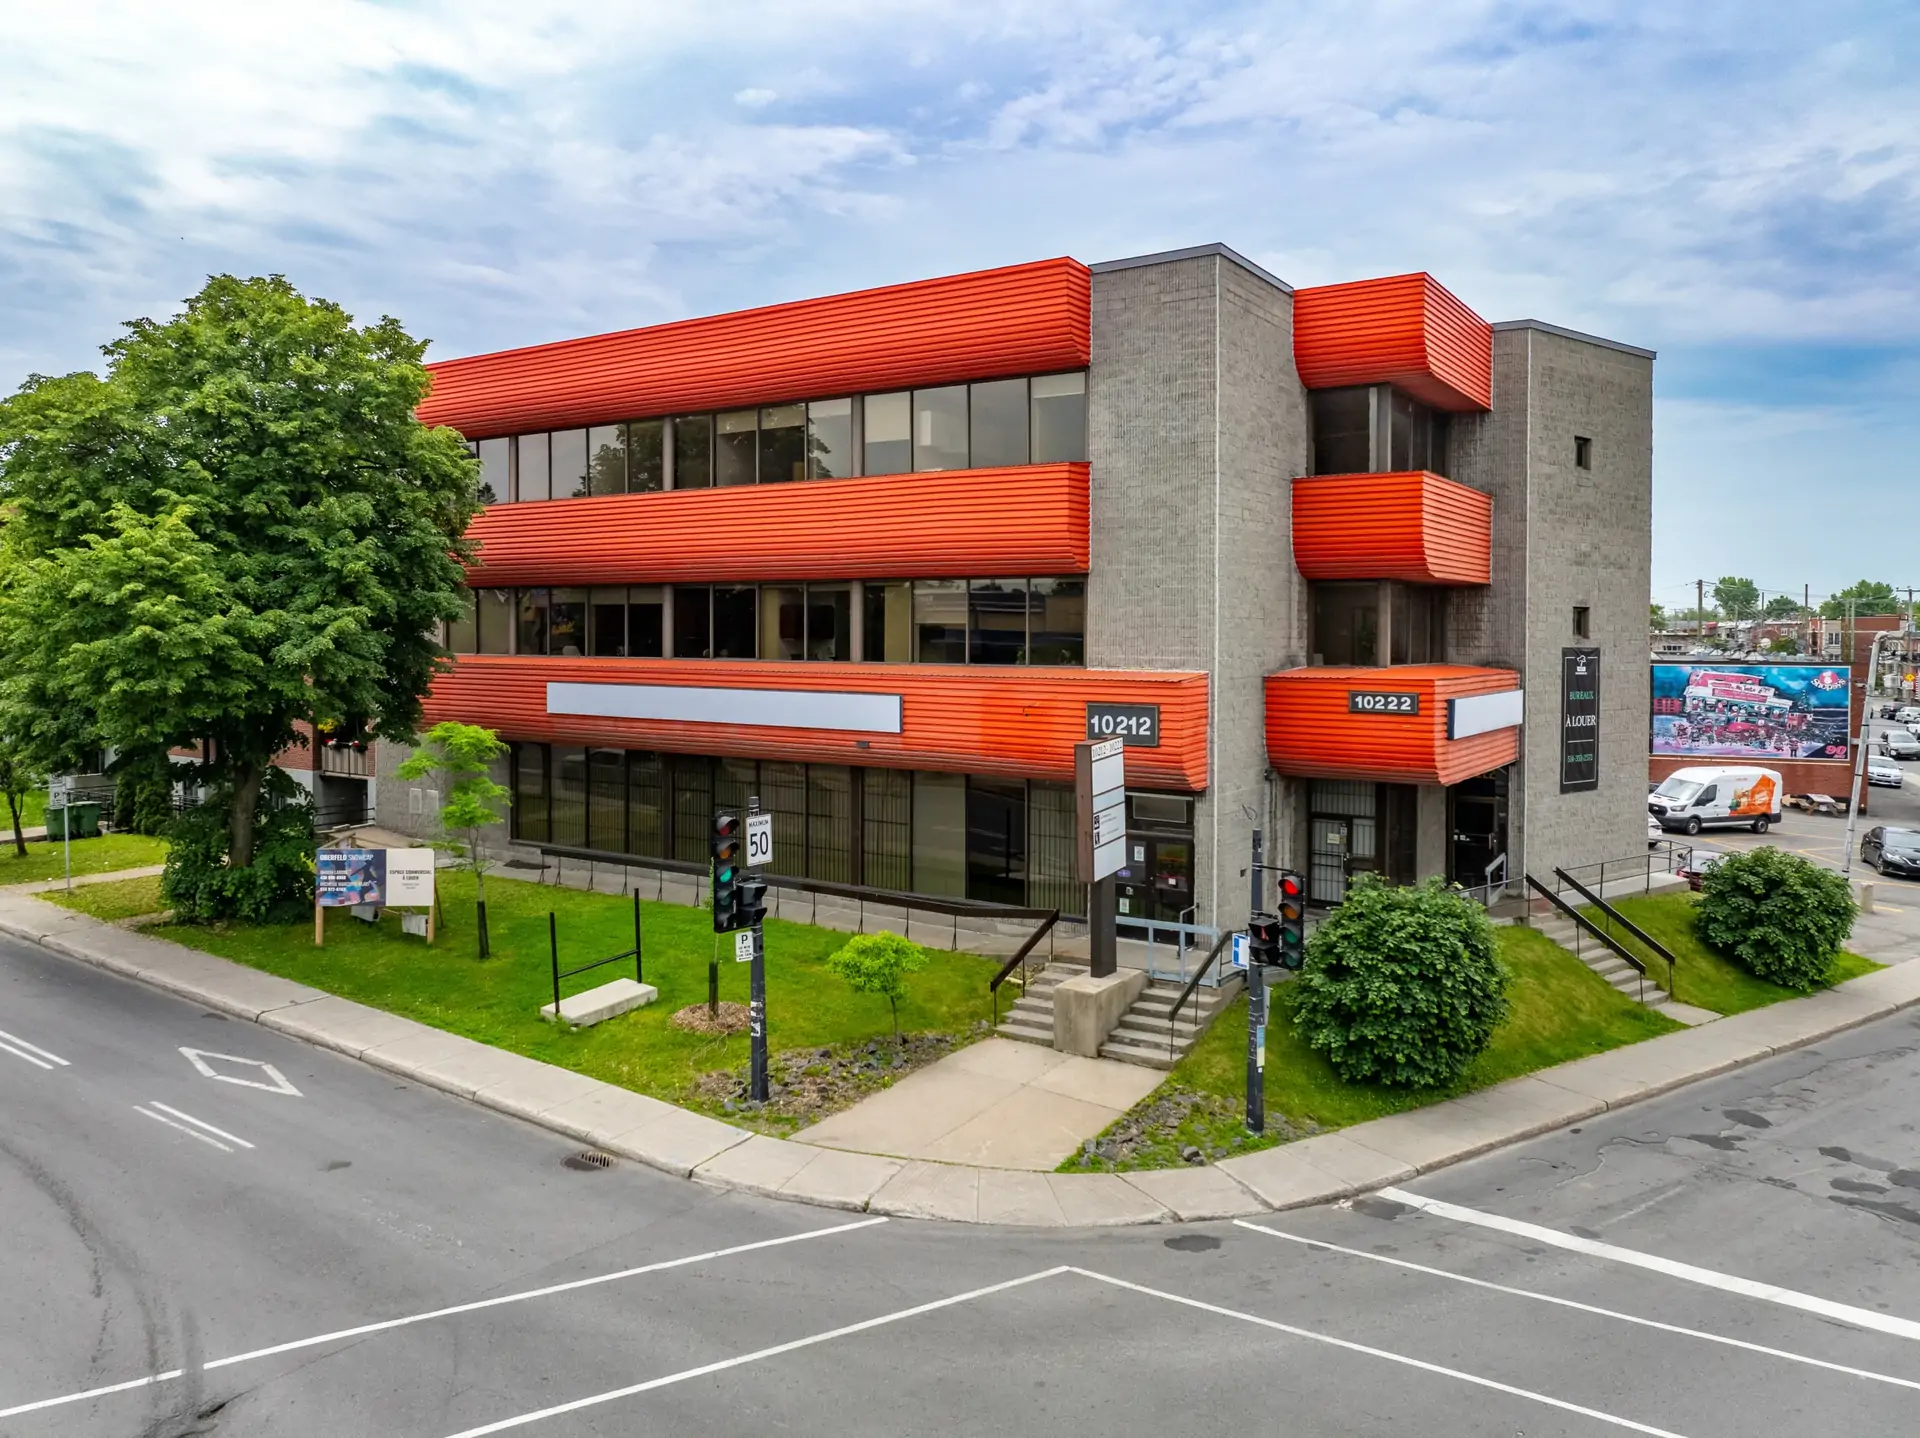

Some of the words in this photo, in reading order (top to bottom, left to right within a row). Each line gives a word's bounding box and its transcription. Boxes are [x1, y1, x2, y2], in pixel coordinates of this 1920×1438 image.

[1569, 690, 1594, 700] BUREAUX
[1354, 695, 1411, 711] 10222
[1090, 714, 1151, 736] 10212
[1565, 713, 1571, 727] À
[1572, 714, 1596, 727] LOUER
[1824, 744, 1847, 755] 90
[748, 820, 769, 829] MAXIMUM
[750, 831, 769, 857] 50
[741, 934, 748, 945] P
